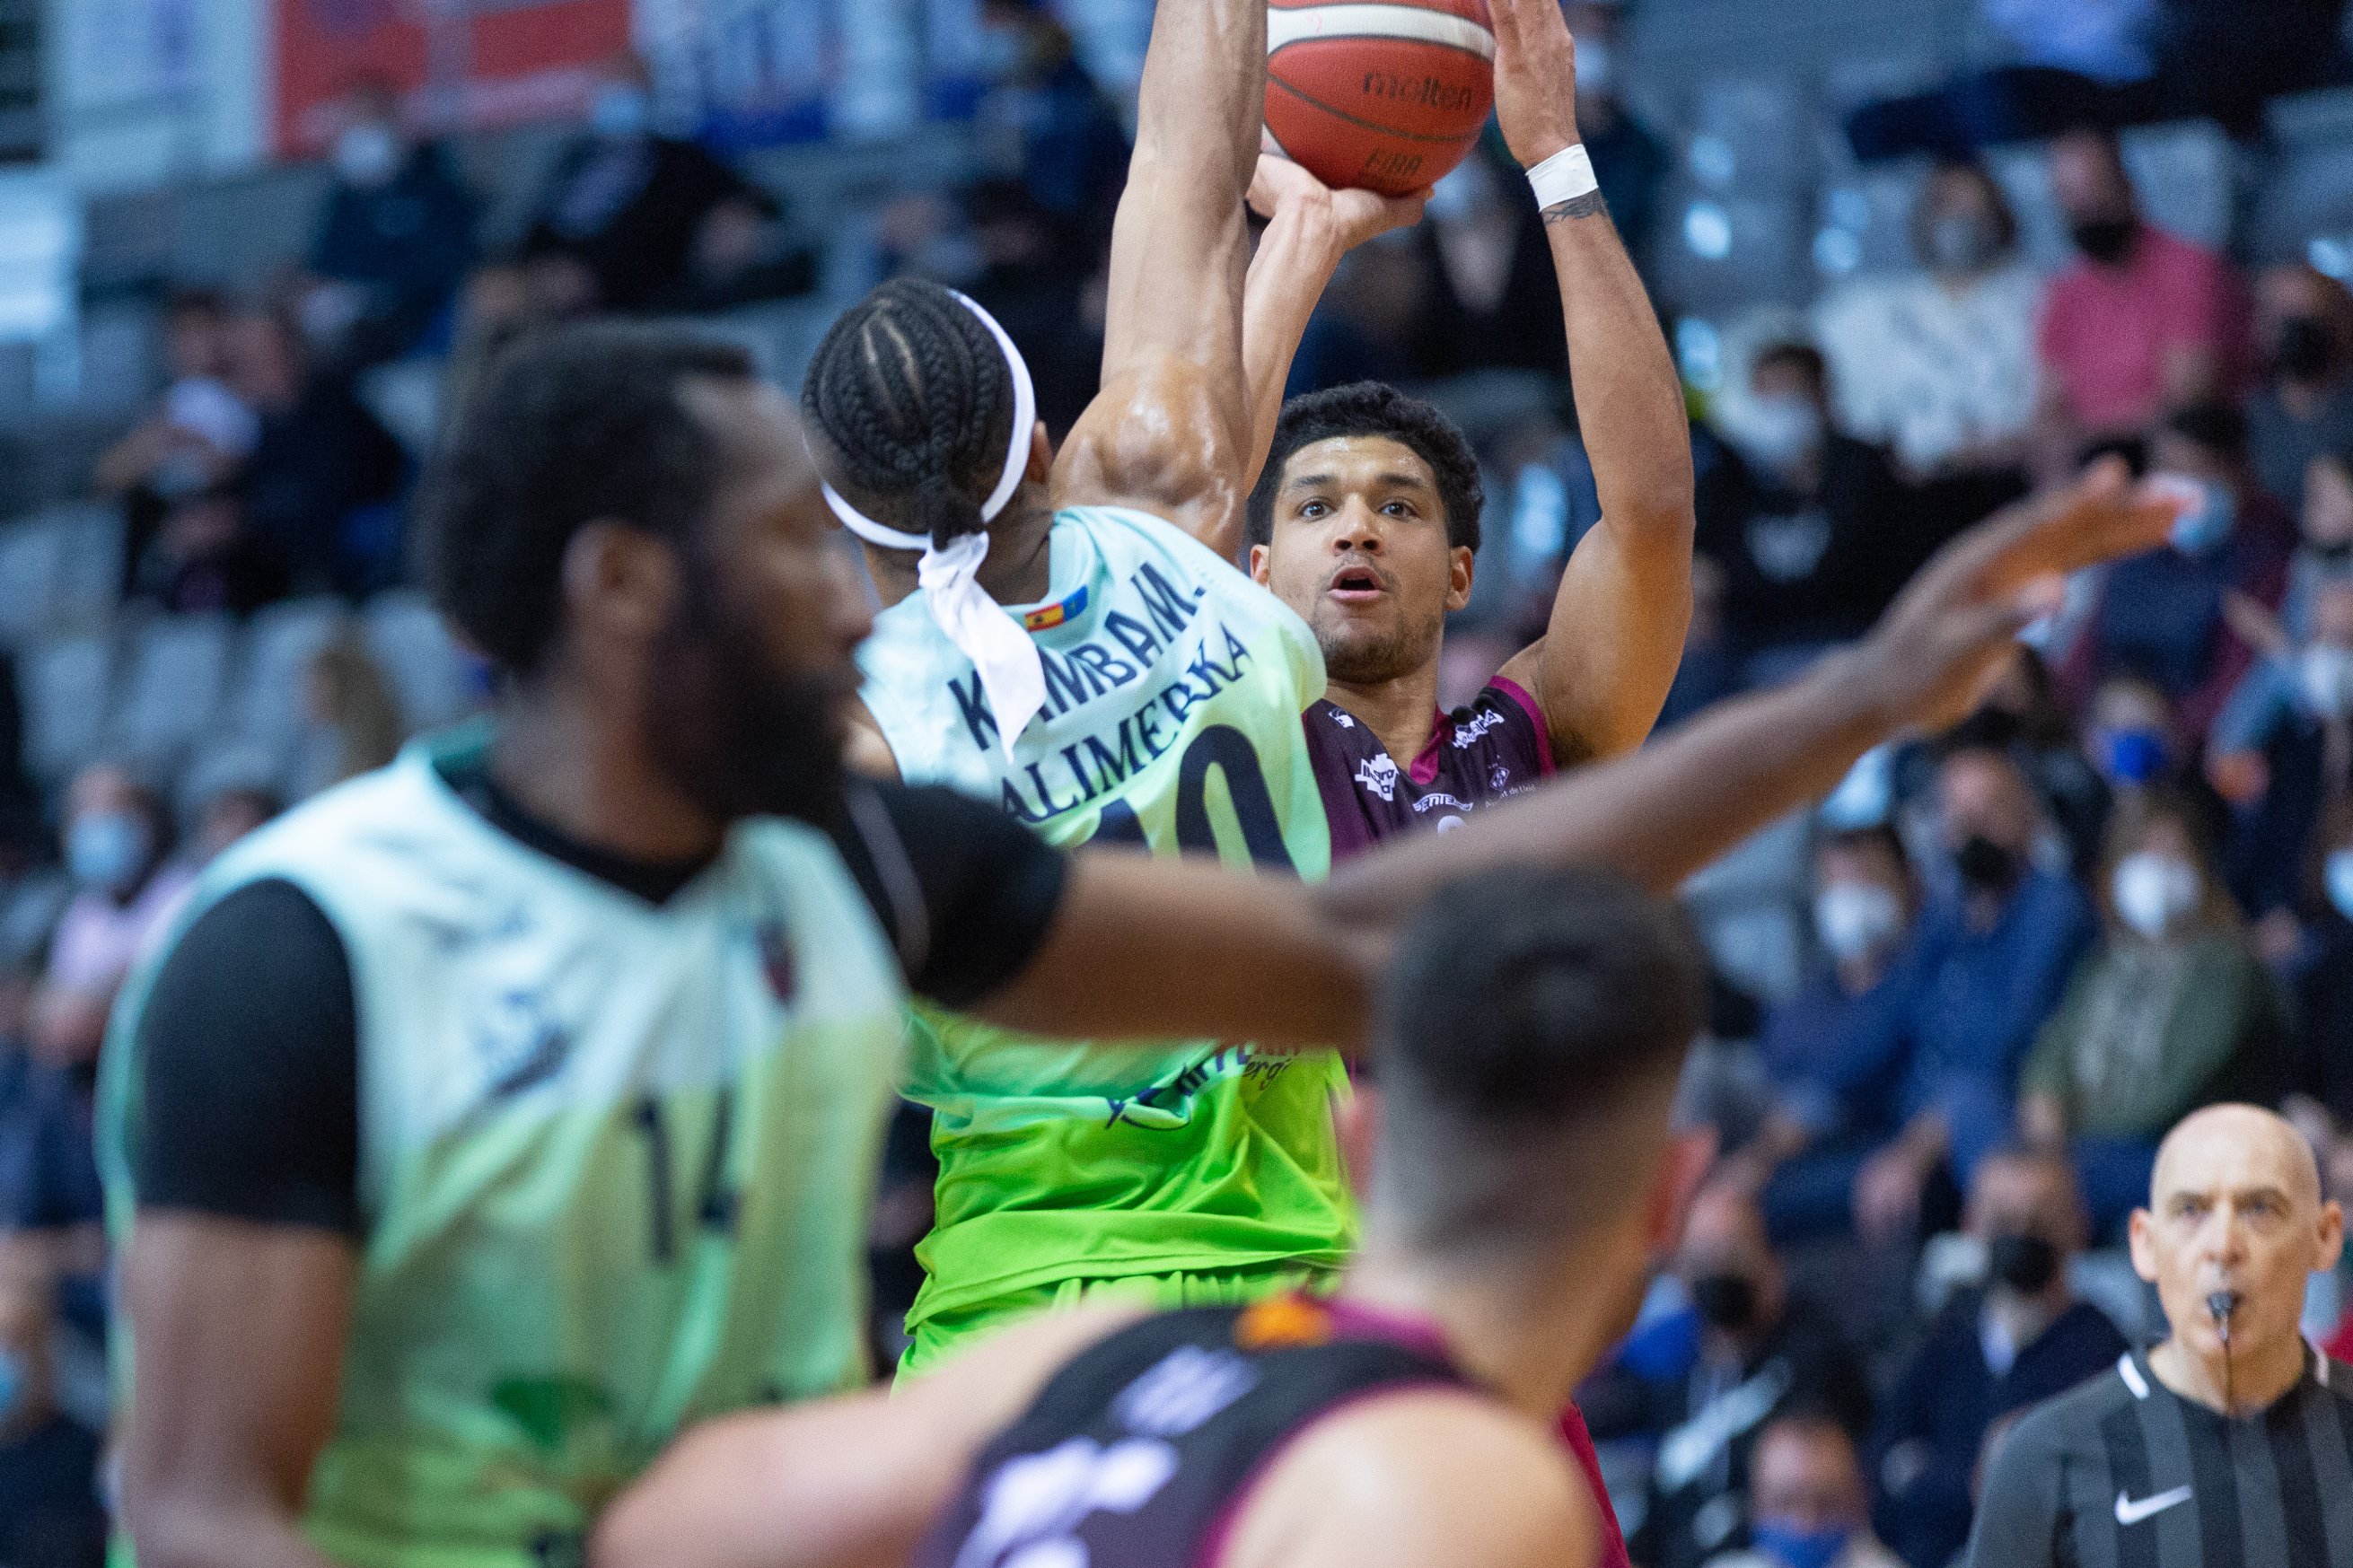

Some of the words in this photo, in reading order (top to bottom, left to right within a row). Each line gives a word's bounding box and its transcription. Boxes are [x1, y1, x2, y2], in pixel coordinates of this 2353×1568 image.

[1364, 72, 1472, 109] molten
[947, 560, 1207, 751] KMBAM.
[999, 620, 1254, 824] ALIMERKA
